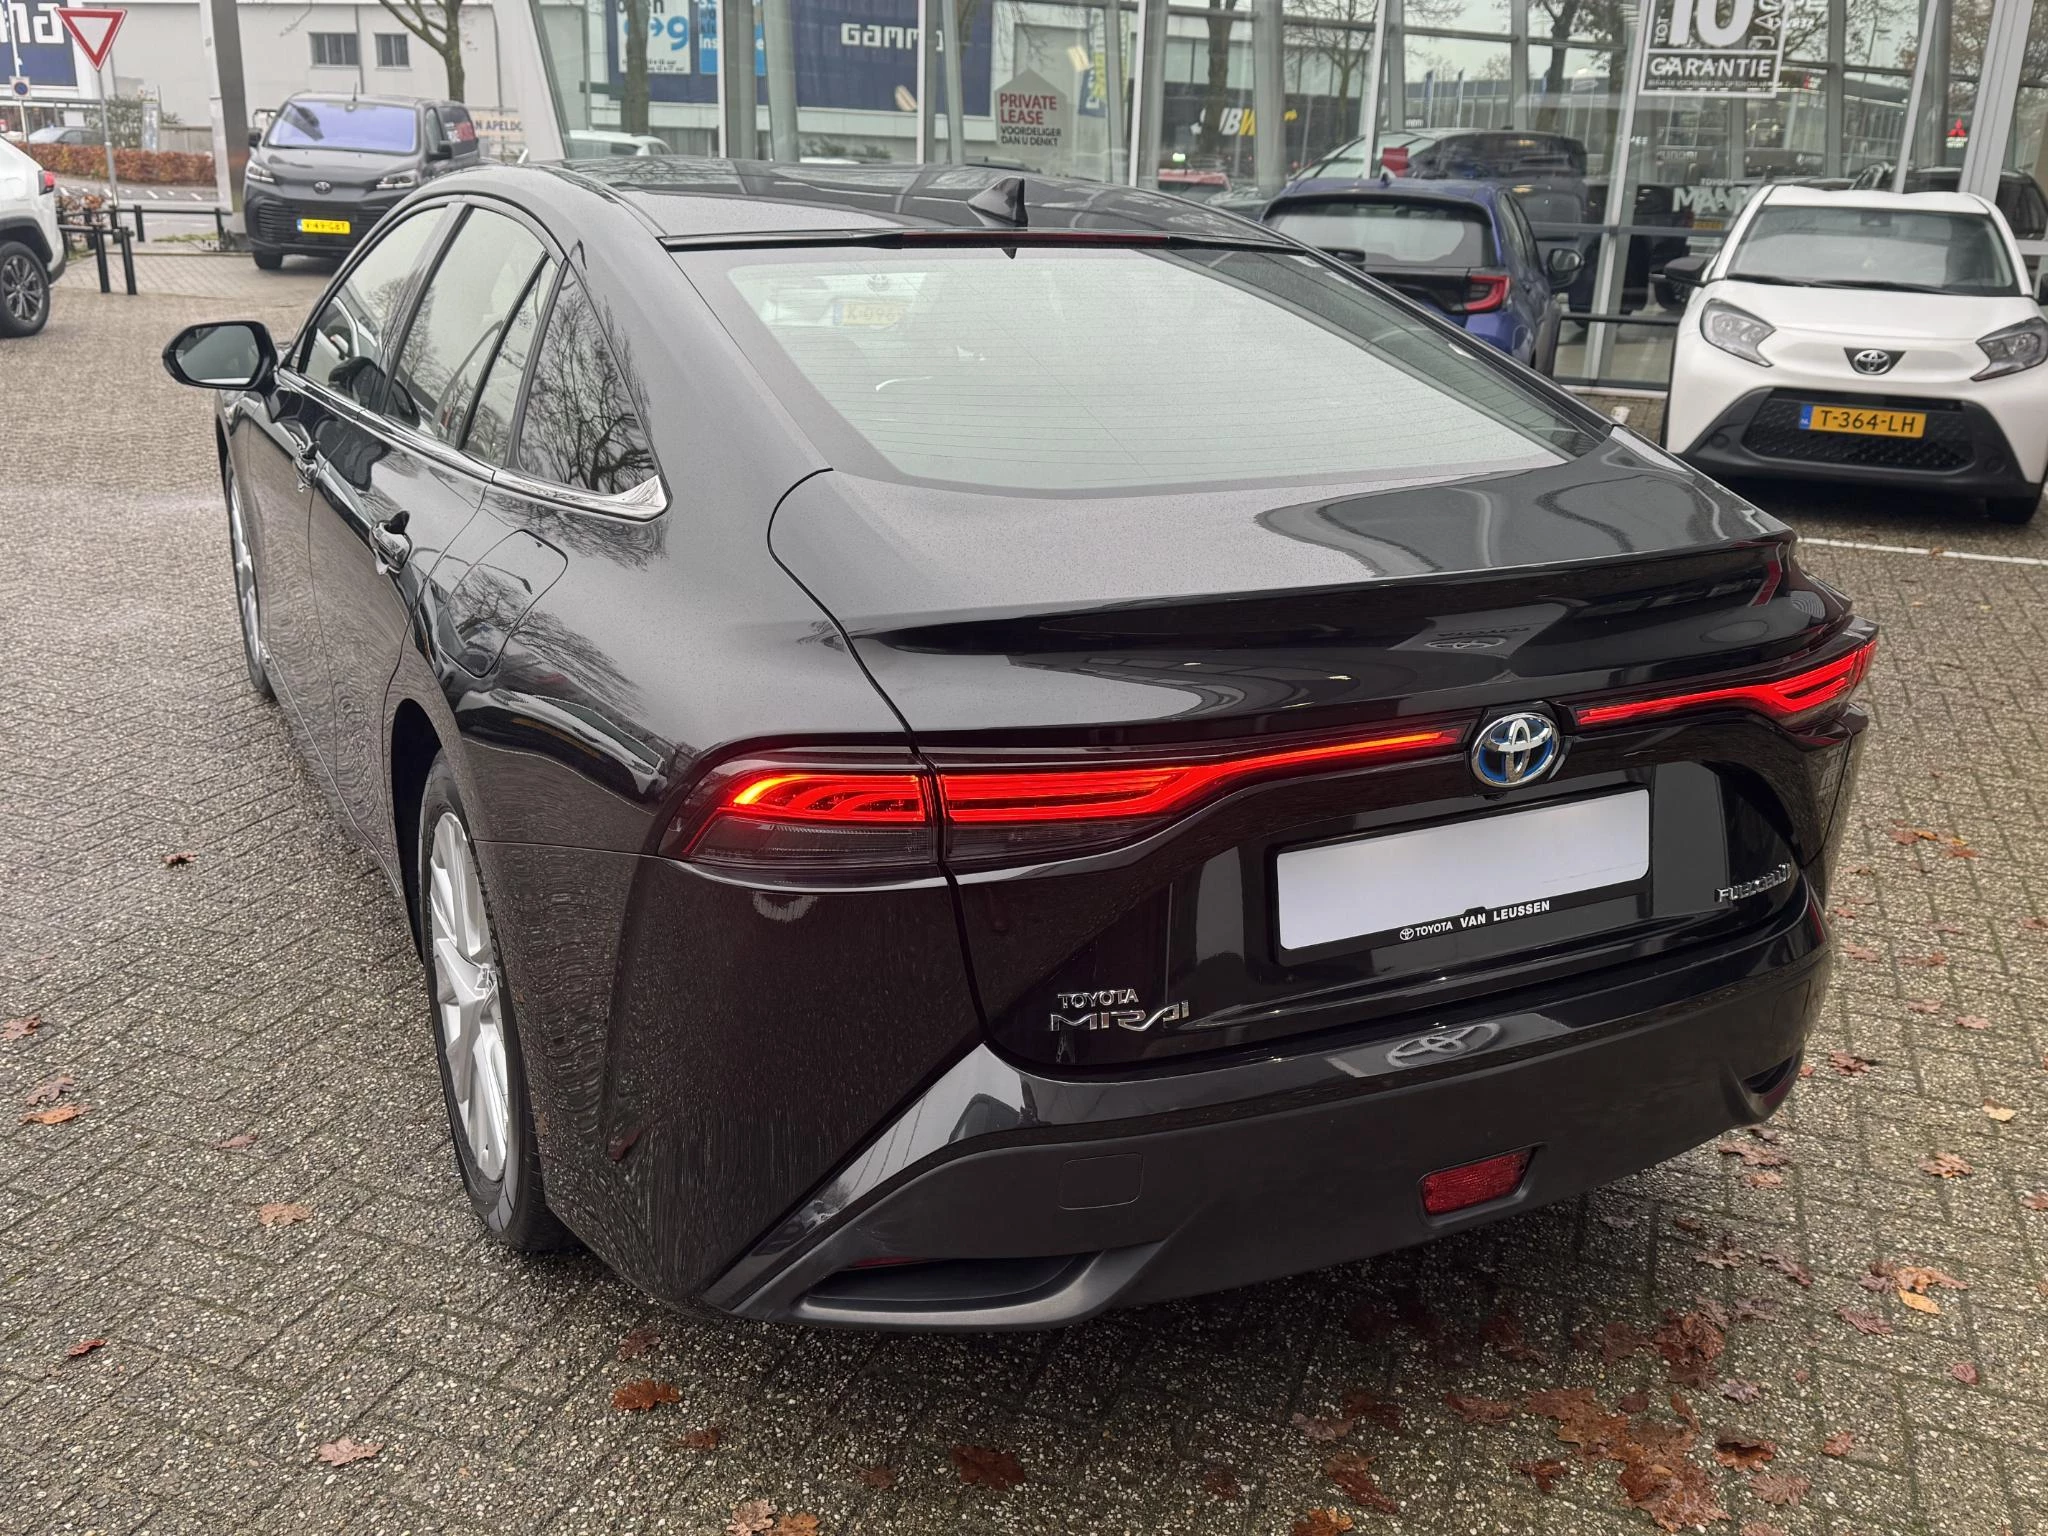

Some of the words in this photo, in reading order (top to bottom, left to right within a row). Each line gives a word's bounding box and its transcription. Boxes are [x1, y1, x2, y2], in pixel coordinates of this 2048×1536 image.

[1654, 16, 1670, 45] TOT
[1669, 0, 1753, 47] 10
[1650, 57, 1772, 78] GARANTIE
[1000, 92, 1057, 110] PRIVATE
[1000, 109, 1044, 125] LEASE
[1001, 126, 1062, 137] VOORDELIGER
[1001, 136, 1019, 144] DAN
[1030, 137, 1058, 146] DENKT
[1820, 409, 1916, 433] T-364-LH
[1415, 921, 1453, 937] TOYOTA
[1460, 913, 1486, 928] VAN
[1493, 900, 1550, 922] LEUSSEN
[1057, 988, 1139, 1009] TOYOTA
[1050, 1000, 1189, 1032] MIRAI
